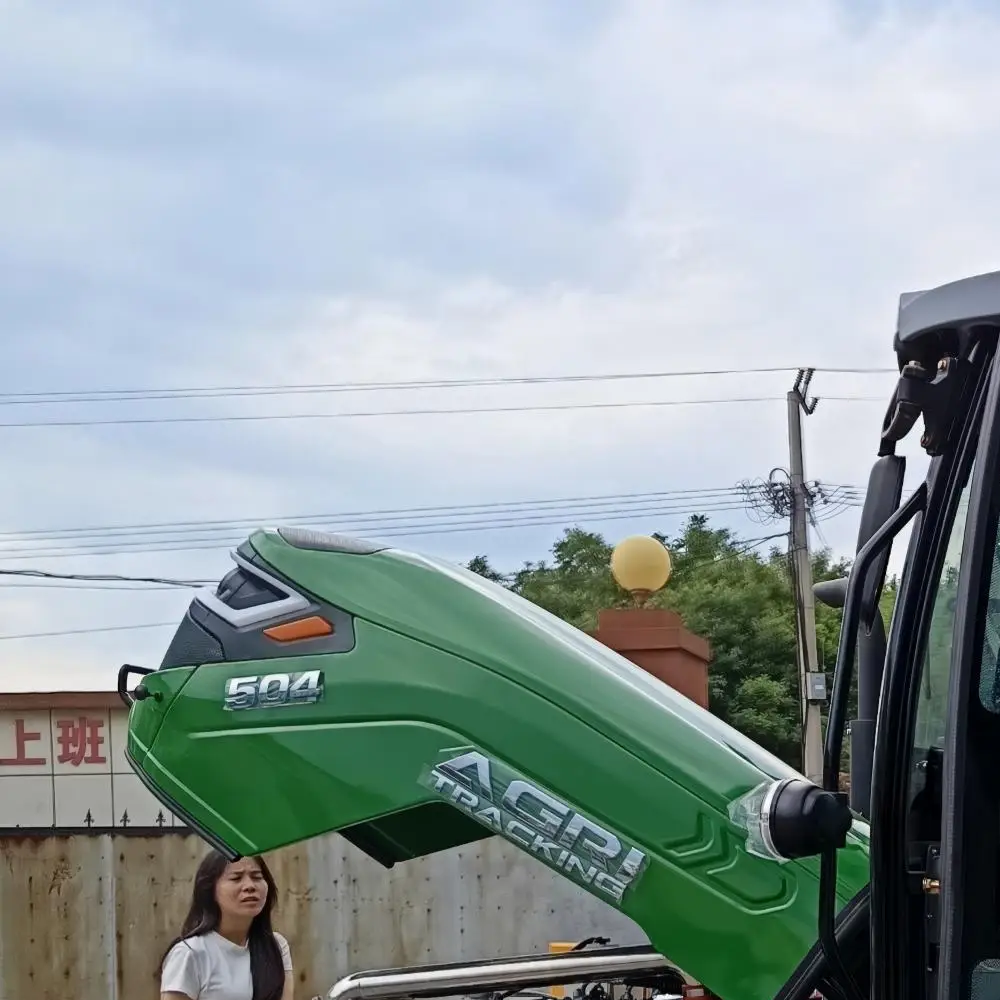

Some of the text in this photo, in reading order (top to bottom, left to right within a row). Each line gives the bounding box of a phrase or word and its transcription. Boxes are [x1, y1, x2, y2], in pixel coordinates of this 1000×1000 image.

[225, 669, 321, 709] 504
[0, 717, 106, 767] 上班
[431, 769, 628, 903] TRACKING
[436, 751, 646, 884] AGRI
